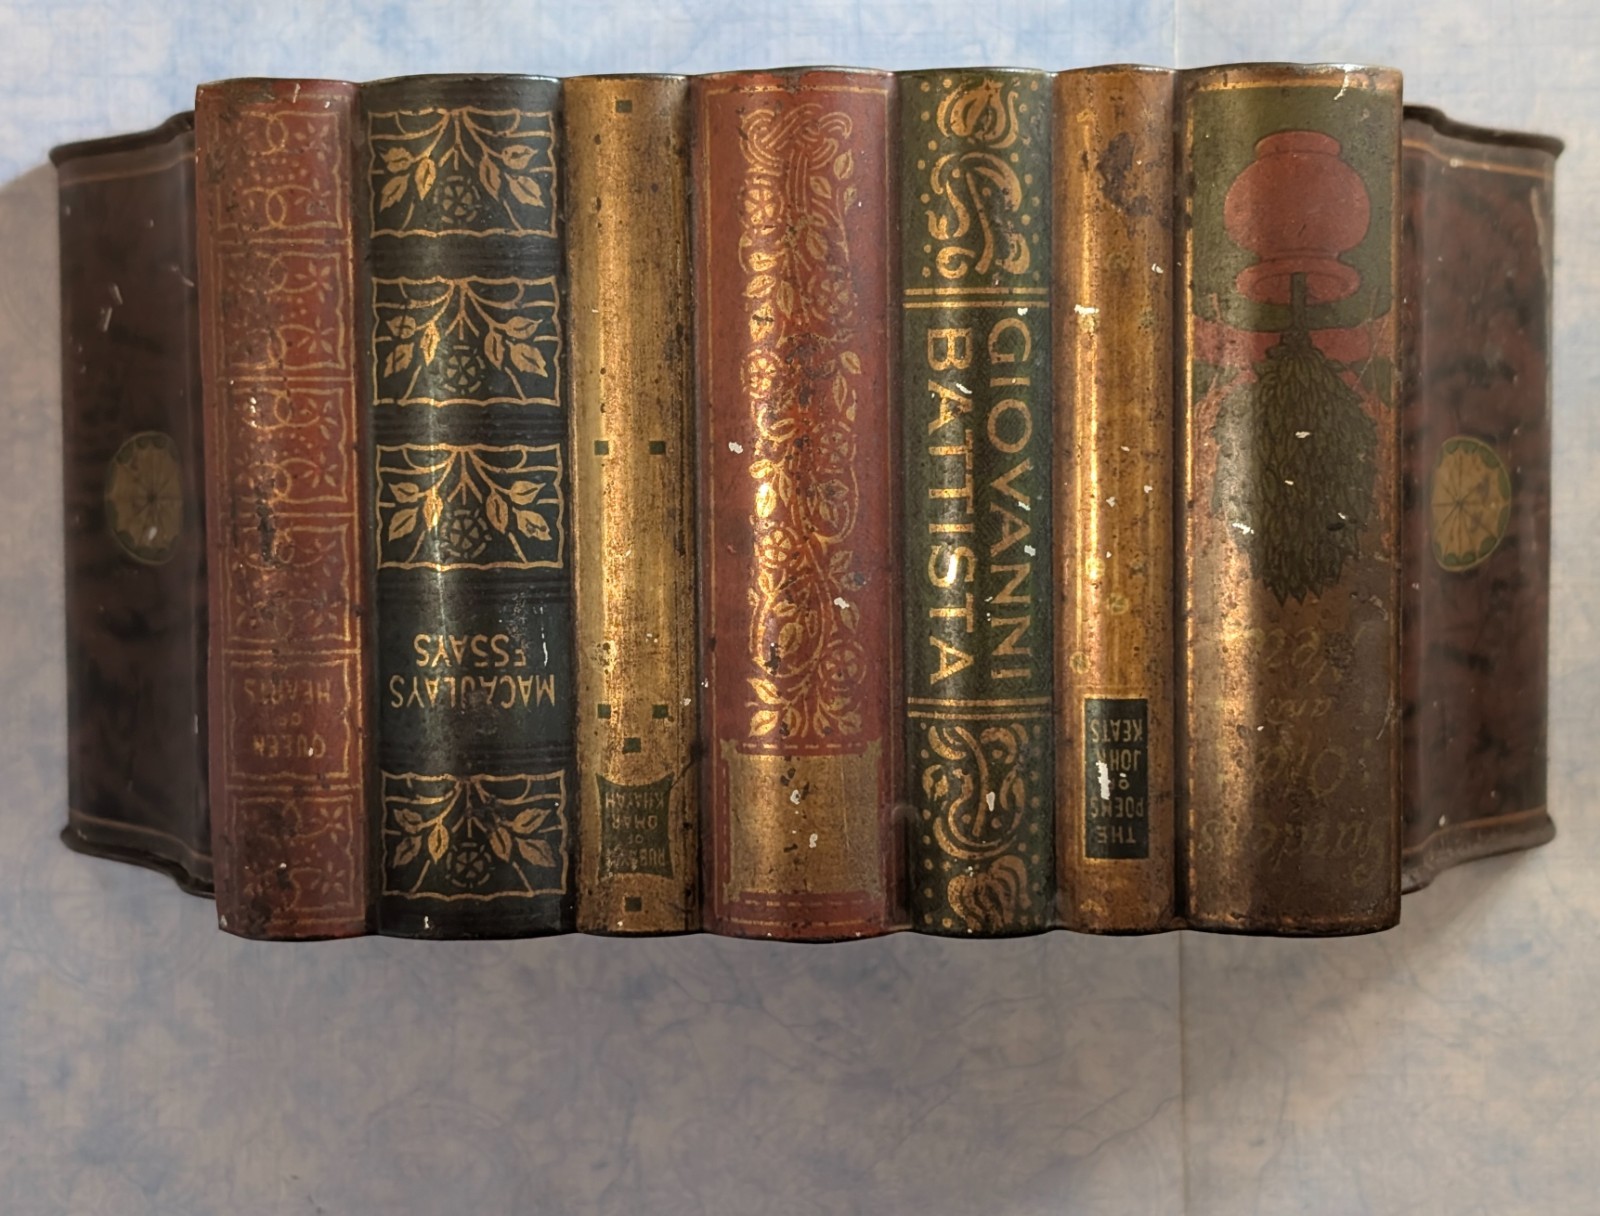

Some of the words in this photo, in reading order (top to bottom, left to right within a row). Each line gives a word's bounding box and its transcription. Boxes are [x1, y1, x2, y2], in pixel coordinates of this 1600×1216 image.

[926, 328, 975, 685] BATTISTA
[986, 317, 1032, 680] GIOVANNI
[413, 633, 528, 667] ESSAYS
[244, 679, 331, 704] HEARTS
[389, 674, 556, 709] MACAULAYS
[1090, 718, 1143, 743] KEATS
[253, 732, 326, 758] QUEEN
[1096, 749, 1141, 771] JOHN
[1090, 796, 1144, 818] POEMS
[1097, 826, 1136, 844] THE
